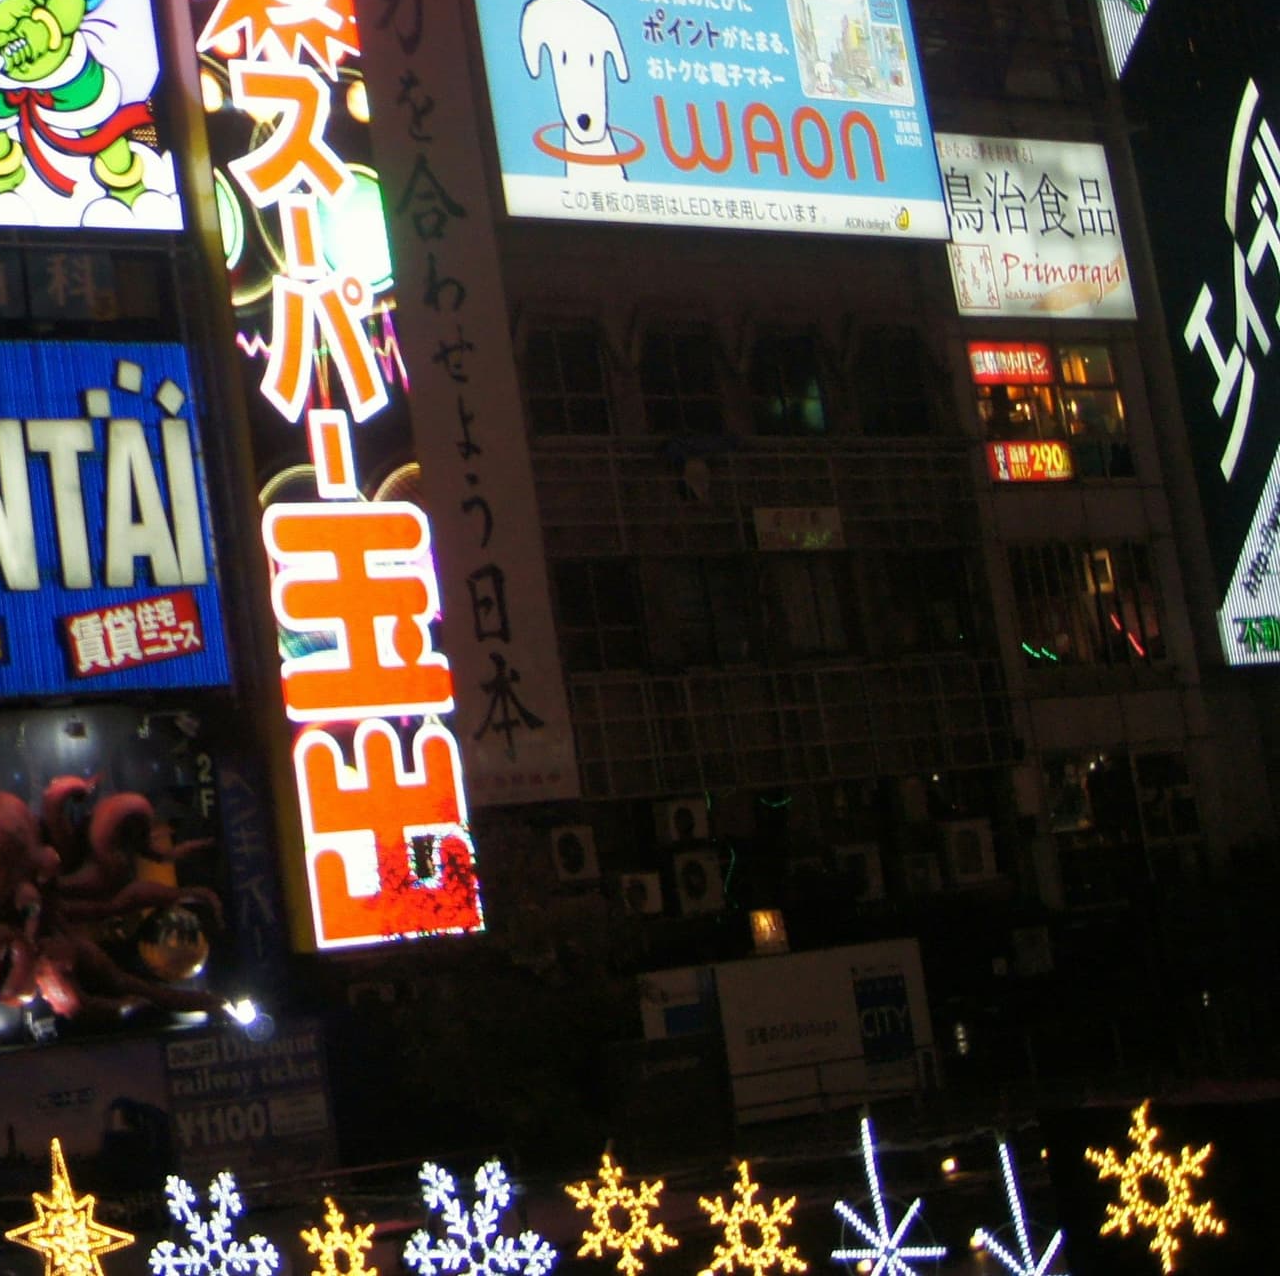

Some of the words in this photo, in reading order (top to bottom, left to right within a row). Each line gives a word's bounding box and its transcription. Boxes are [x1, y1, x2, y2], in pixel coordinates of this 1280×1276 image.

[646, 55, 786, 90] おトクな電子マネー
[653, 94, 887, 184] WAON
[70, 610, 141, 673] 賃貸
[195, 750, 216, 819] 2F
